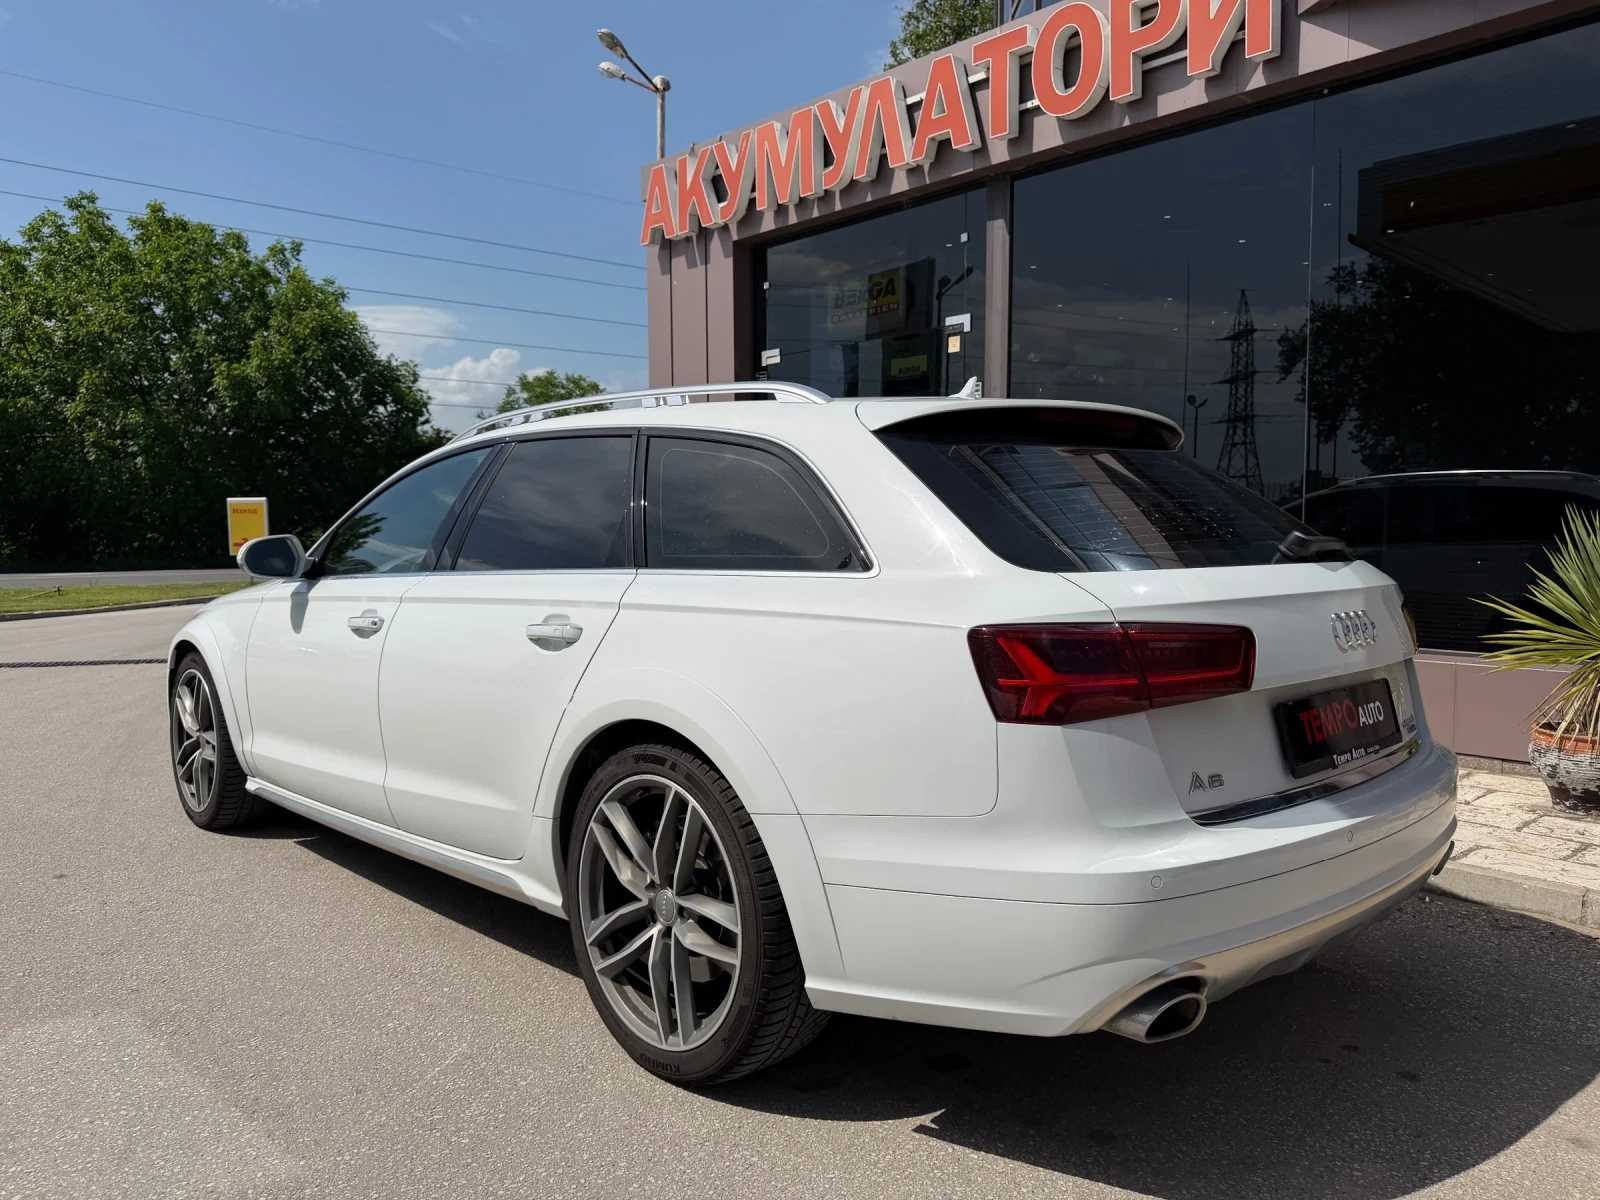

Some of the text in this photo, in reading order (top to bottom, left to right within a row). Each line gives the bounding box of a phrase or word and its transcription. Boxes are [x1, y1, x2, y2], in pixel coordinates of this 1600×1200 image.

[640, 0, 1280, 246] АКУМУЛАТОРИ
[1298, 699, 1384, 744] TEMPO AUTO
[1188, 771, 1225, 796] A6
[639, 1052, 681, 1074] KUMHO
